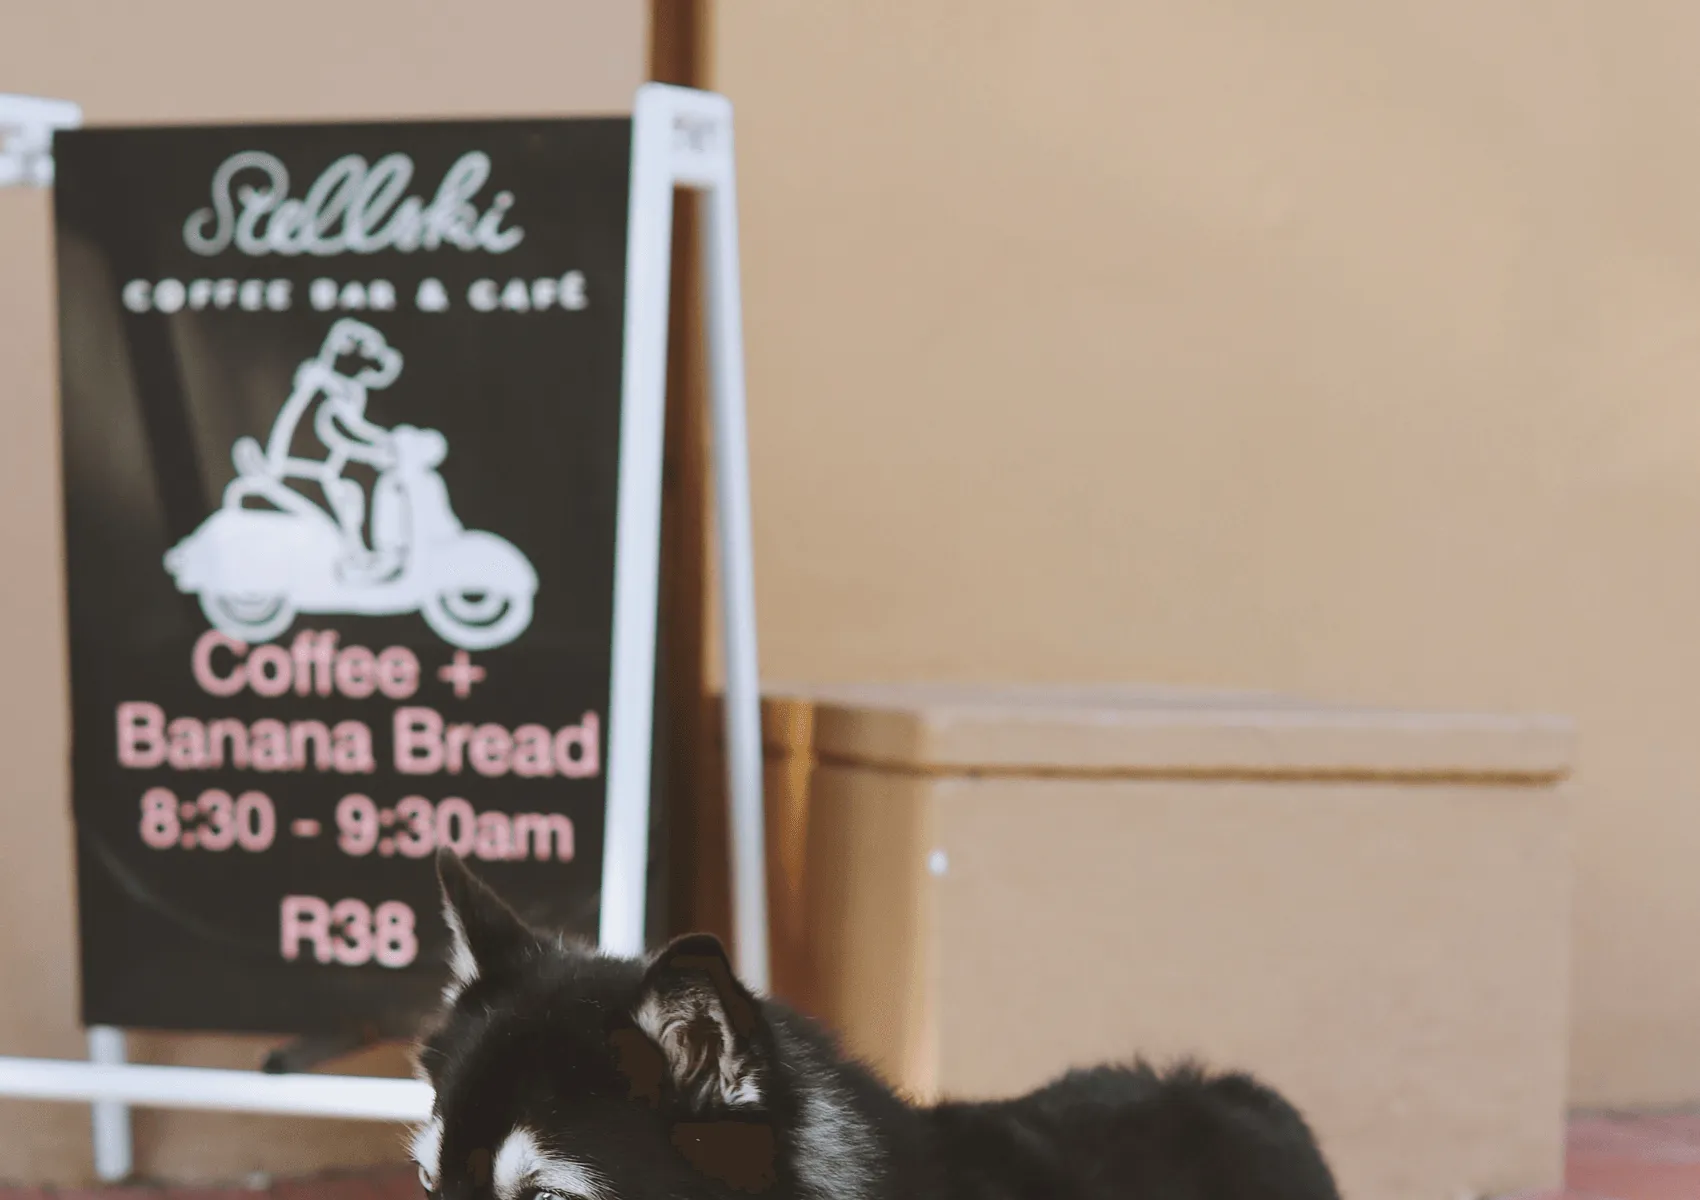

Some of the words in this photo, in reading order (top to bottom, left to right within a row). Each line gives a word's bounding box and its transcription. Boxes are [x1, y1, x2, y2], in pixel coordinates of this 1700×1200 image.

[122, 277, 294, 314] COFFEE
[191, 629, 420, 698] Coffee
[437, 650, 487, 696] +
[115, 701, 375, 774] Banana
[393, 706, 600, 779] Bread
[140, 787, 276, 850] 8:30
[291, 818, 321, 837] -
[335, 793, 575, 862] 9:30am
[280, 895, 418, 968] R38
